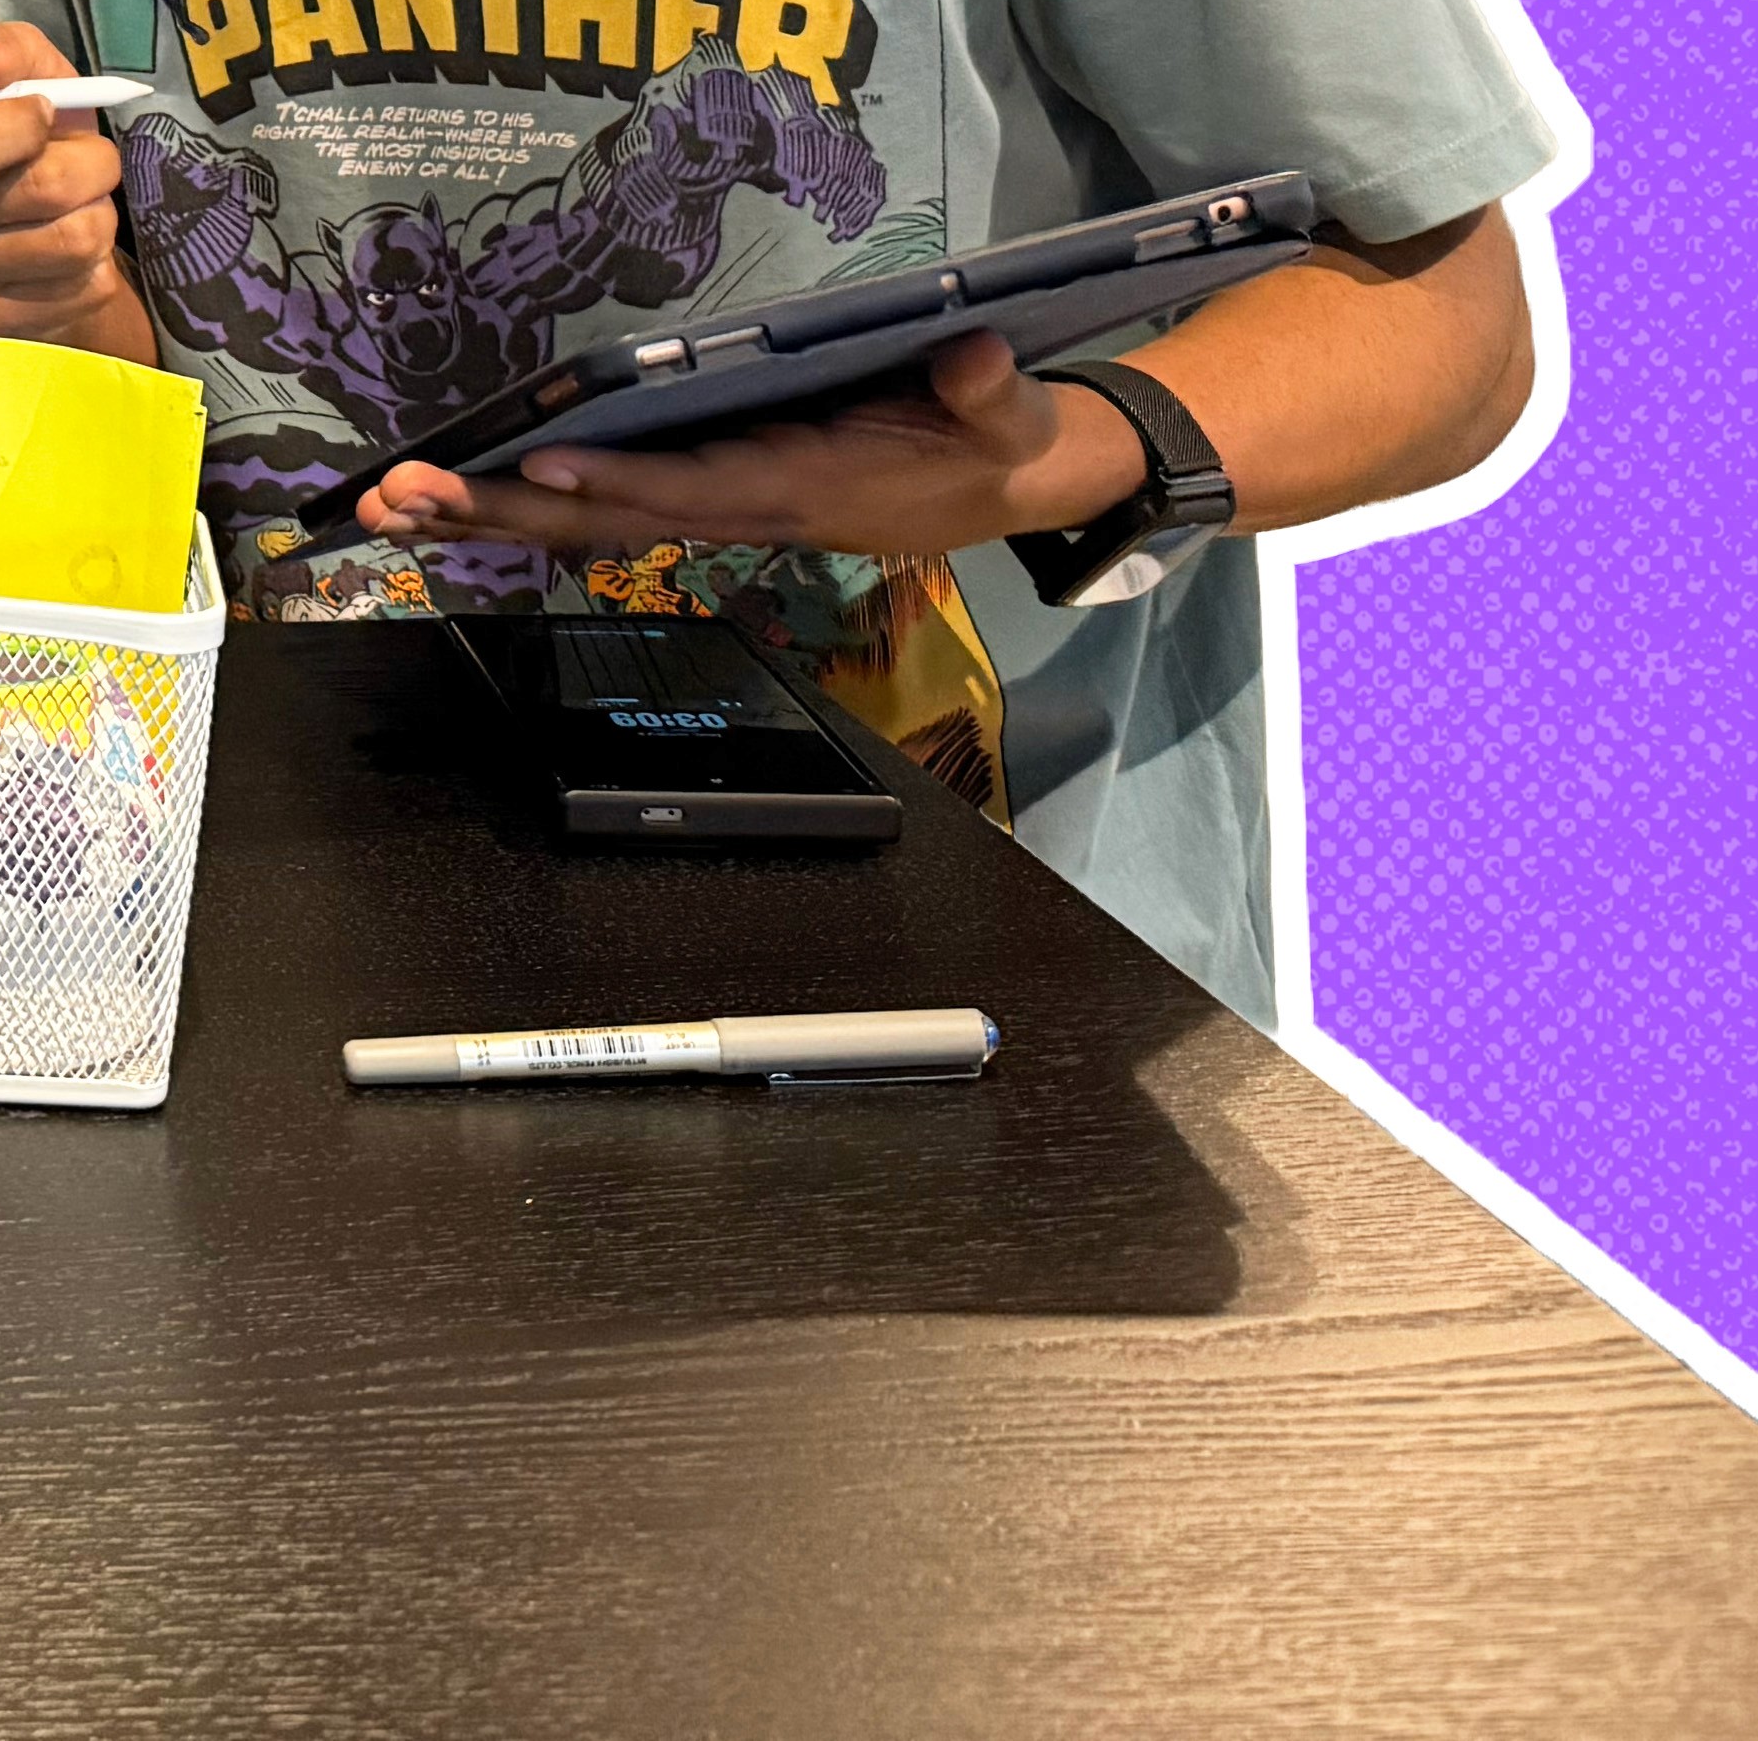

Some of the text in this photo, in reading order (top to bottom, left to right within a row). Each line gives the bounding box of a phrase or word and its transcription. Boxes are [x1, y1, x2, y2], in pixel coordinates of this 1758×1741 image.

[860, 93, 883, 107] TM
[380, 106, 466, 126] RETURNS
[473, 108, 497, 127] TO
[501, 112, 534, 129] HIS
[252, 123, 348, 141] RIGHTFUL
[519, 131, 578, 149] WAITS
[314, 141, 531, 164] THE MOST INSIDIOUS
[337, 159, 415, 177] ENEMY
[418, 161, 448, 177] OF
[608, 711, 728, 730] 03:09
